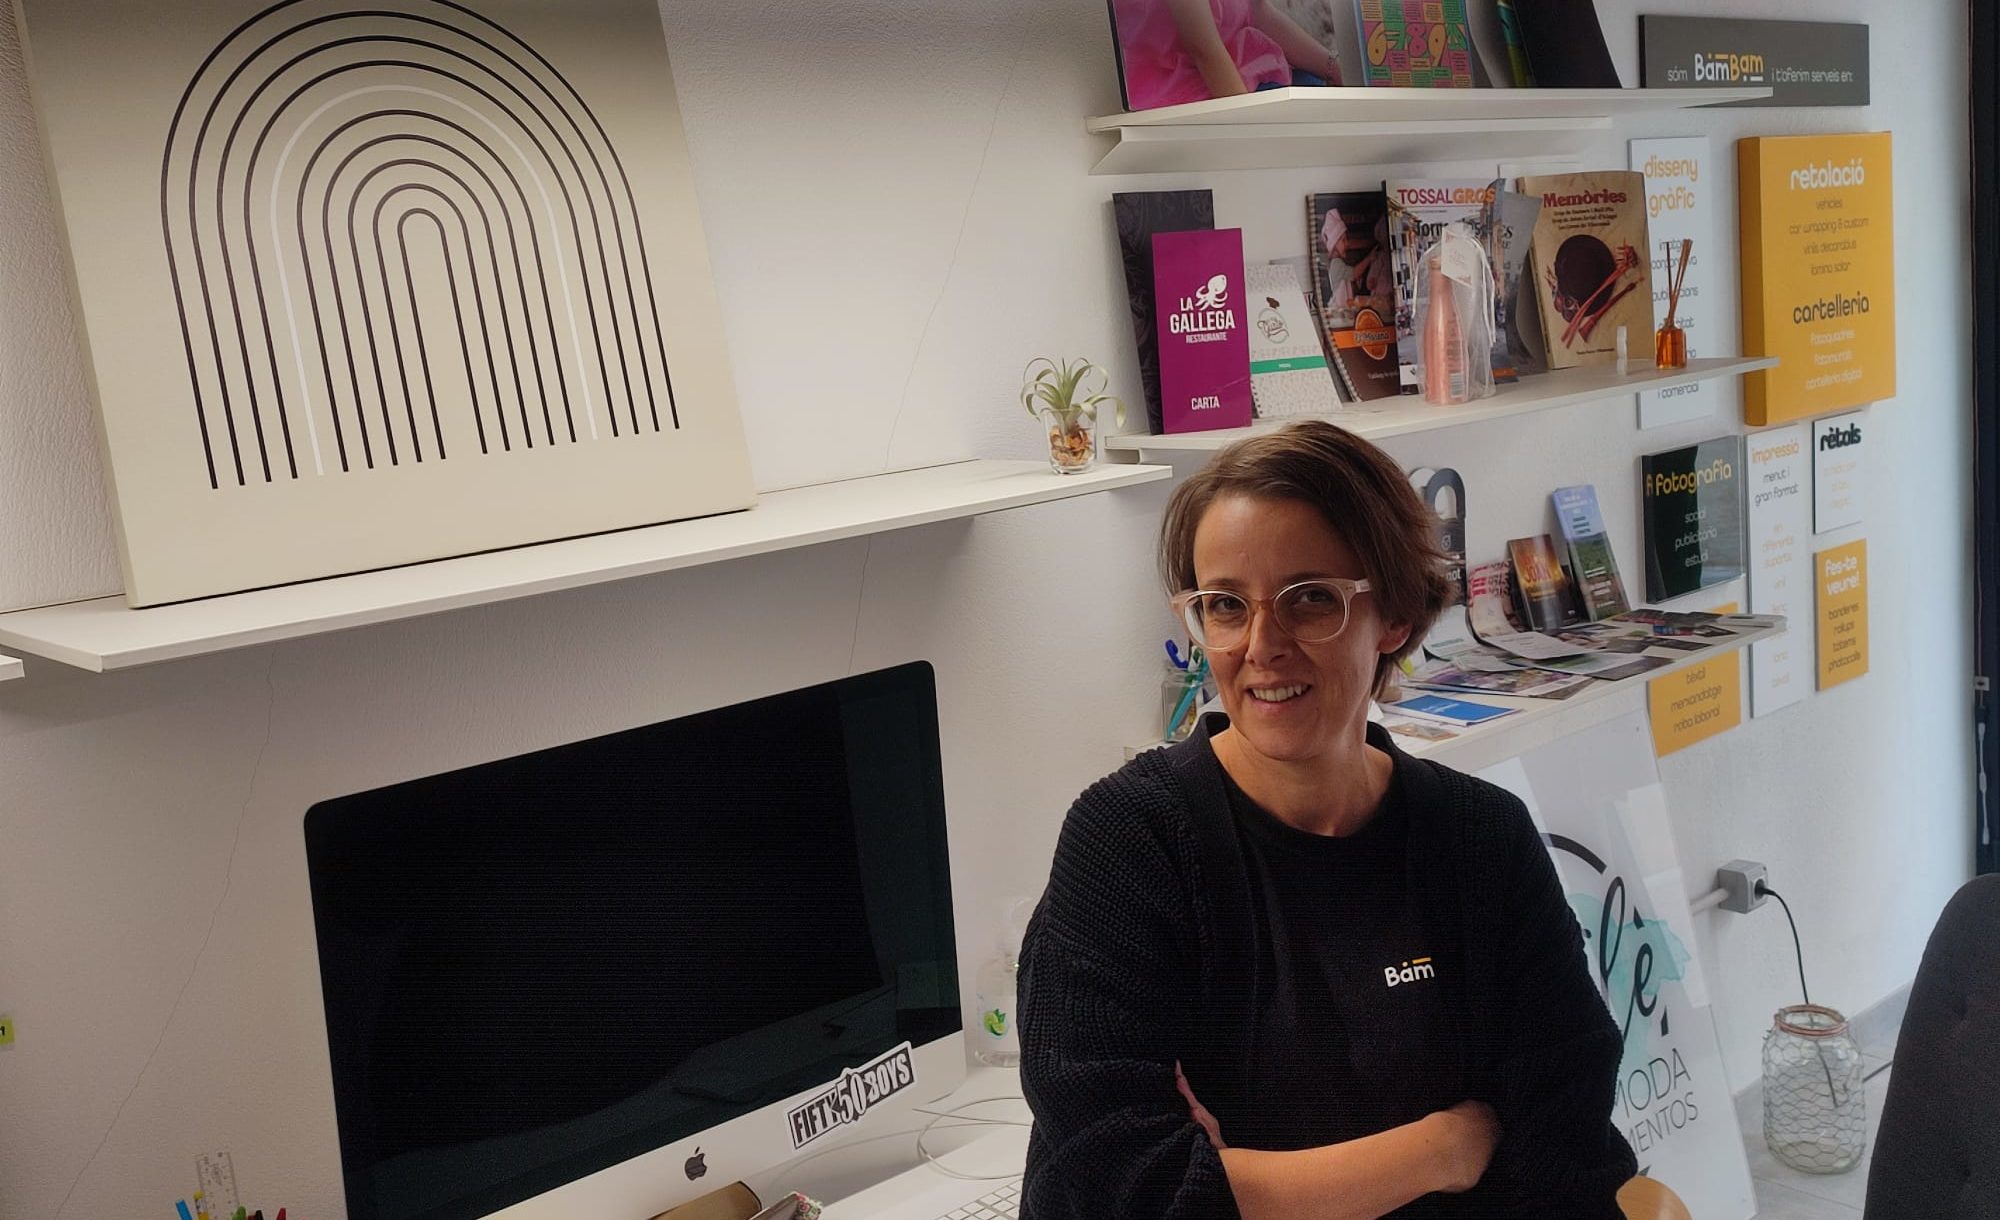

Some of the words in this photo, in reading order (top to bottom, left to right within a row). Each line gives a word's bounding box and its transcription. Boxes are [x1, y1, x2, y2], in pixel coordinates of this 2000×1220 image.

[1644, 154, 1698, 182] disseny
[1790, 158, 1865, 191] retolació
[1543, 188, 1628, 208] Memòries
[1649, 186, 1696, 218] gràfic
[1180, 297, 1194, 312] LA
[1792, 290, 1870, 325] cartelleria
[1169, 309, 1236, 334] GALLEGA
[1185, 331, 1228, 344] RESTAURANTE
[1191, 395, 1220, 410] CARTA
[1820, 422, 1862, 452] rètols
[1656, 458, 1732, 497] fotografia
[836, 1072, 868, 1125] 50
[862, 1052, 912, 1103] BOYS
